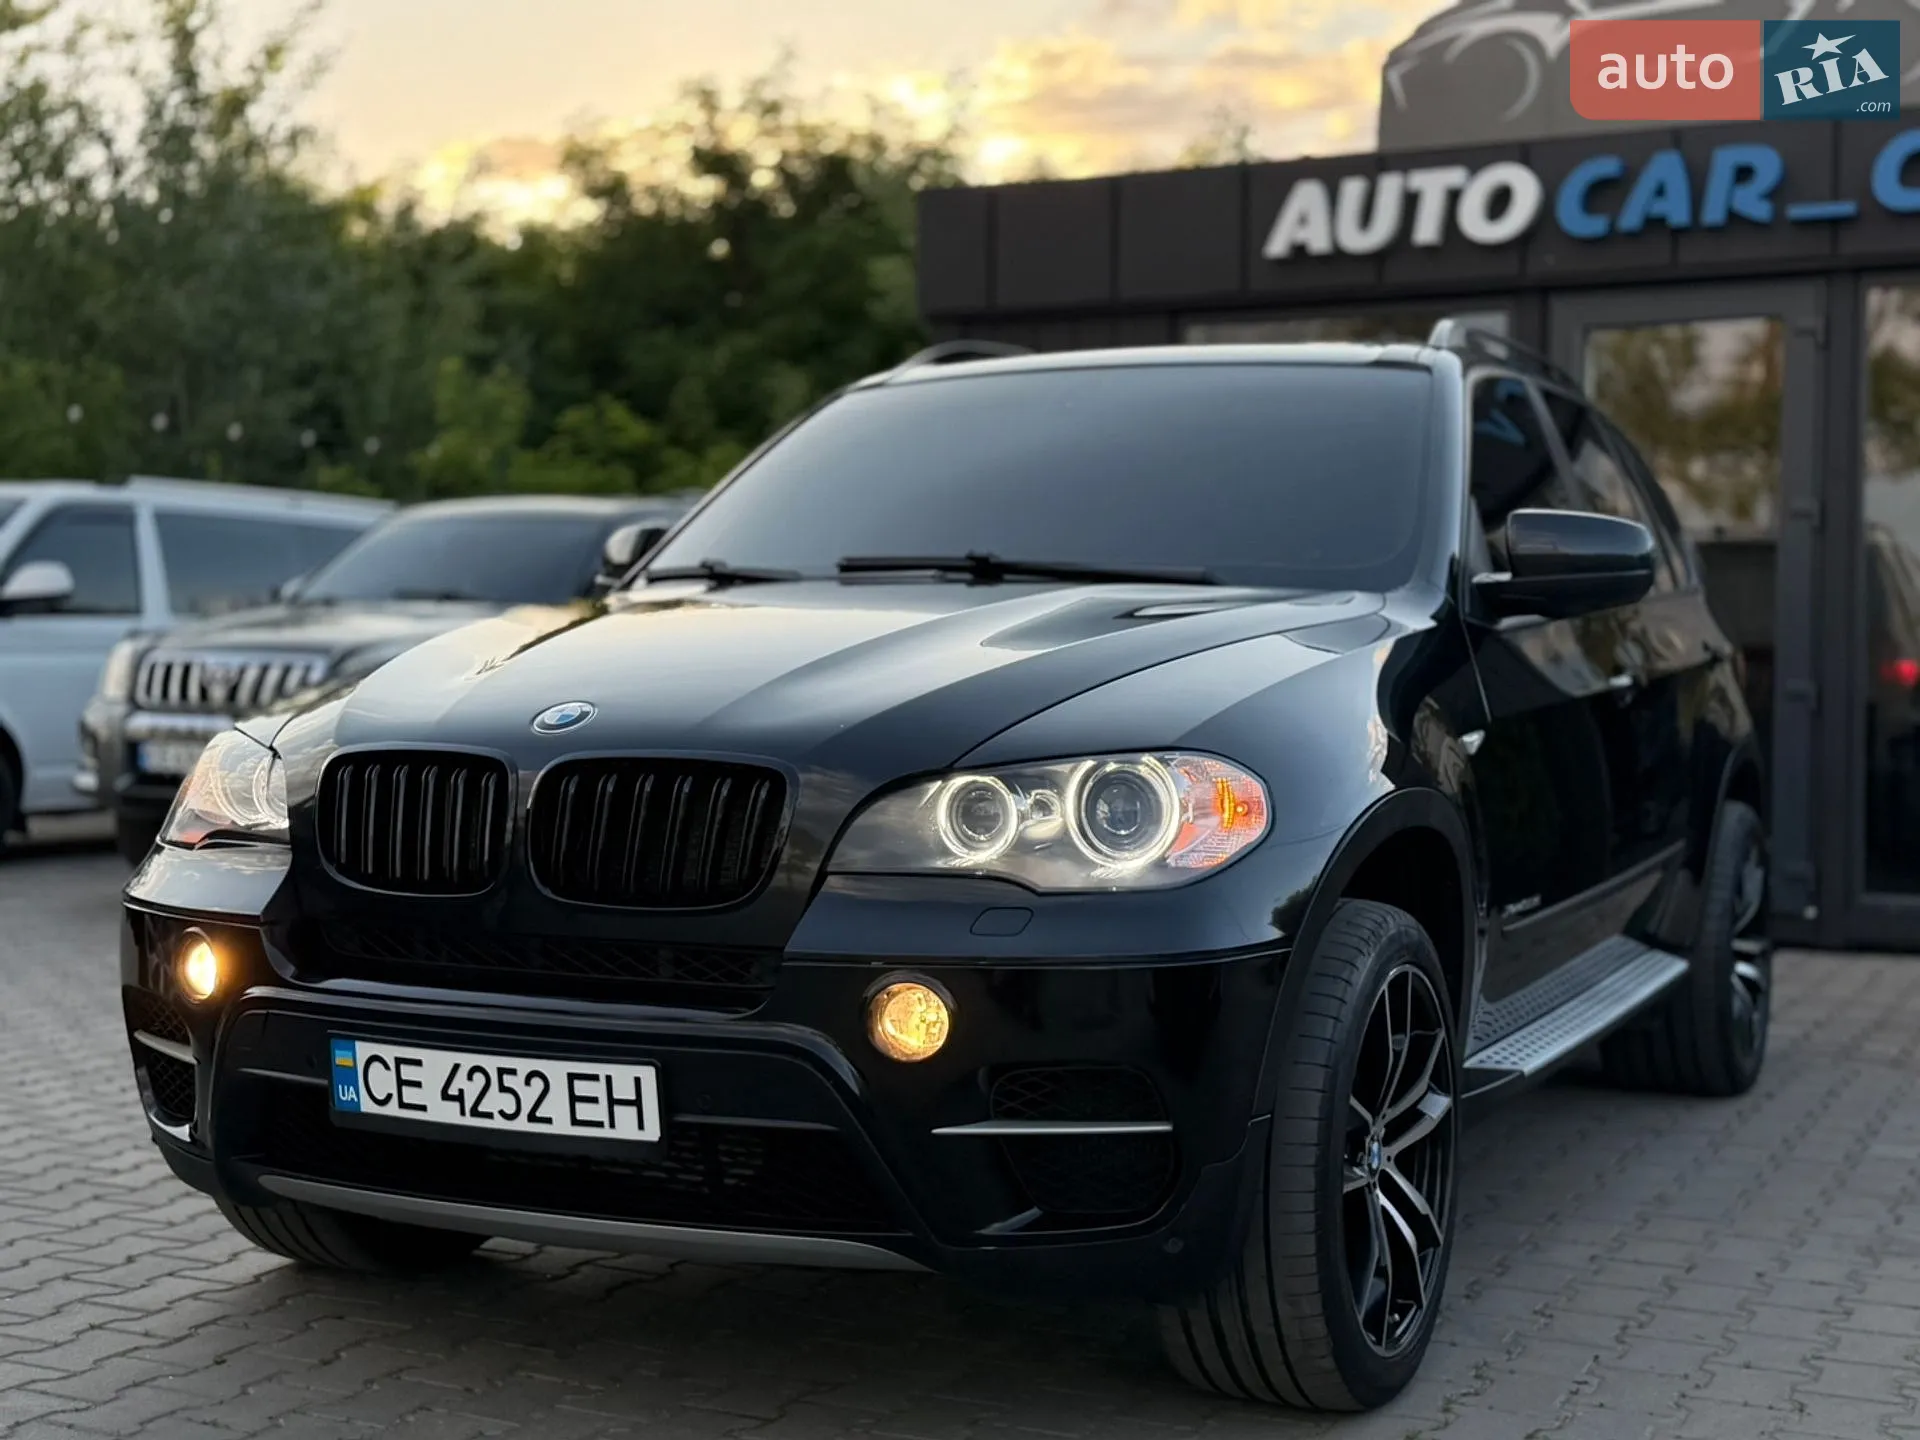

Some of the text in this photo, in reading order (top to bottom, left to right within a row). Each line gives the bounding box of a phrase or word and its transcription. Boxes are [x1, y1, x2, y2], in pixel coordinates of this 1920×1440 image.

[1263, 162, 1543, 259] AUTO
[338, 1084, 359, 1102] UA
[363, 1054, 645, 1131] CE 4252 EH
